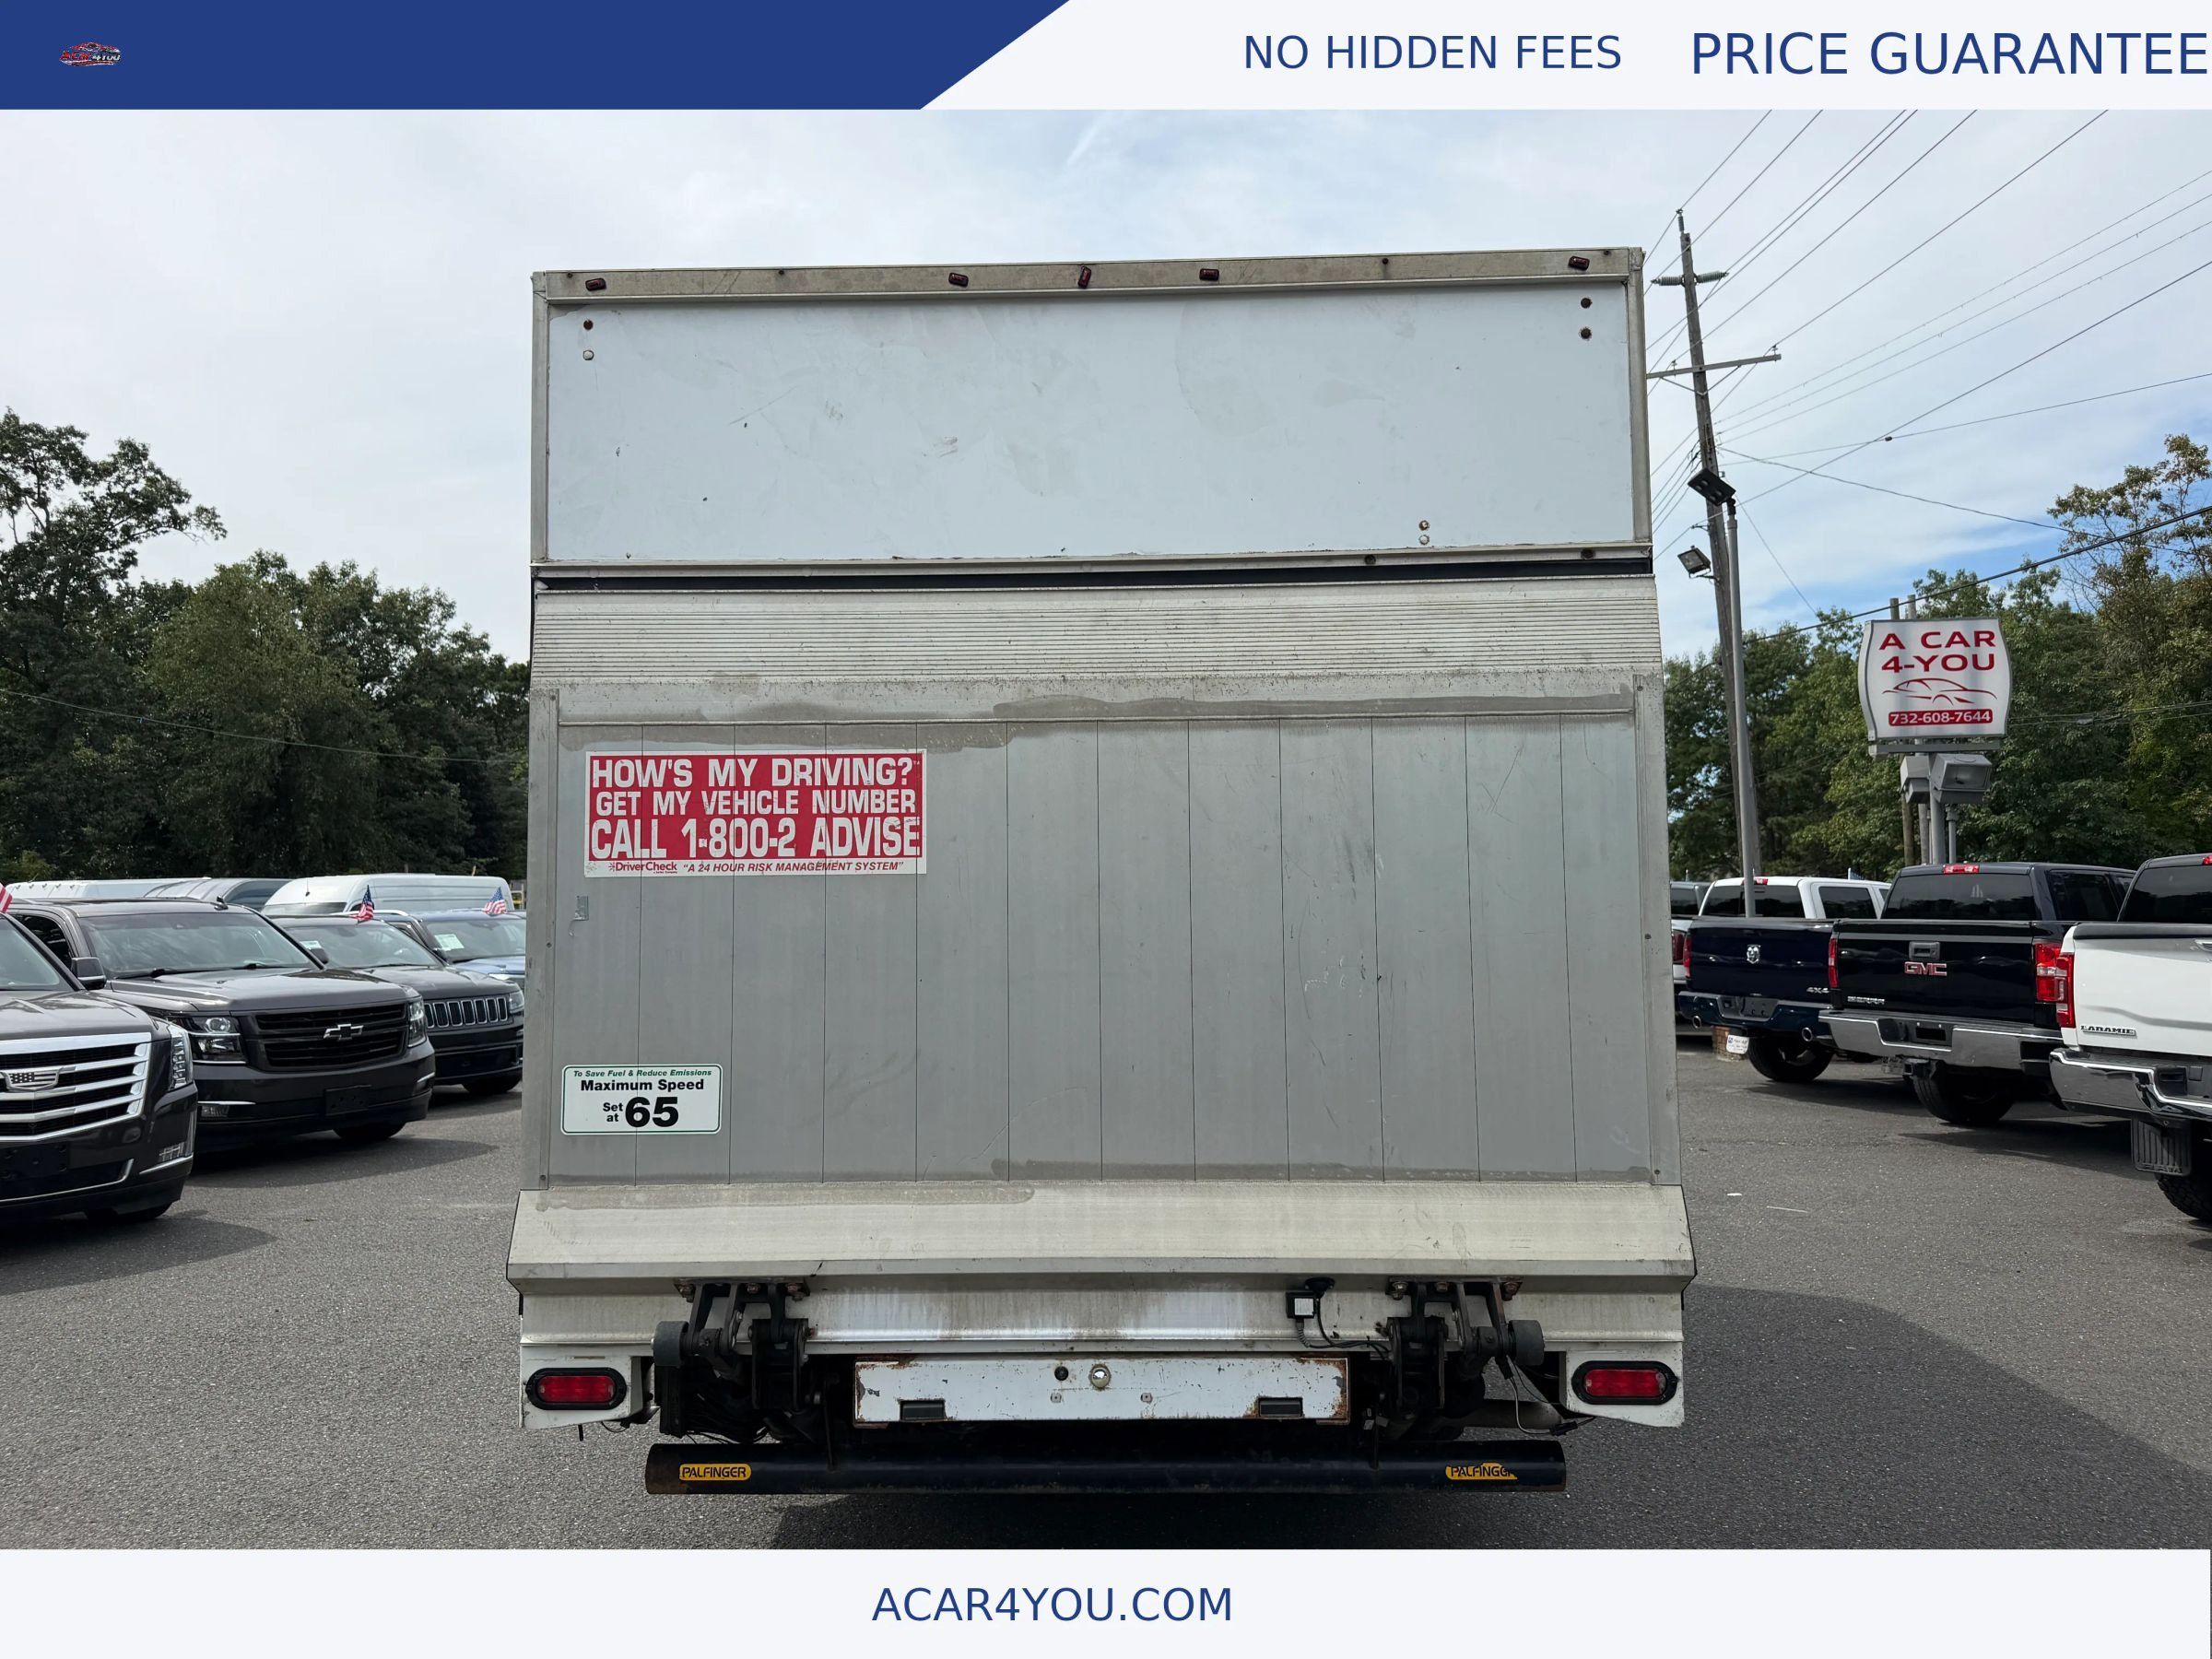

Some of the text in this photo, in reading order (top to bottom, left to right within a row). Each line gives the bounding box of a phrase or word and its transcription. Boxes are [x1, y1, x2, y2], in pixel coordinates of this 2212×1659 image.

[1878, 630, 1996, 651] A CAR
[1881, 653, 1994, 674] 4-YOU
[1890, 711, 1991, 724] 732-608-7644
[593, 758, 912, 788] HOW'S MY DRIVING?
[596, 788, 917, 816] GET MY VEHICLE NUMBER
[592, 816, 921, 859] CALL 1-800-2 ADVISE
[615, 862, 677, 871] DriverCheck
[699, 863, 711, 872] 24
[712, 863, 745, 872] HOUR
[747, 863, 772, 871] RISK
[775, 862, 853, 871] MANAGEMENT
[1904, 961, 1947, 976] GMC
[636, 1069, 667, 1077] Reduce
[670, 1068, 712, 1077] Emissions
[581, 1078, 704, 1092] Maximum Speed
[603, 1096, 679, 1128] Set 65
[606, 1112, 619, 1123] at
[682, 1466, 747, 1477] PALFINGER
